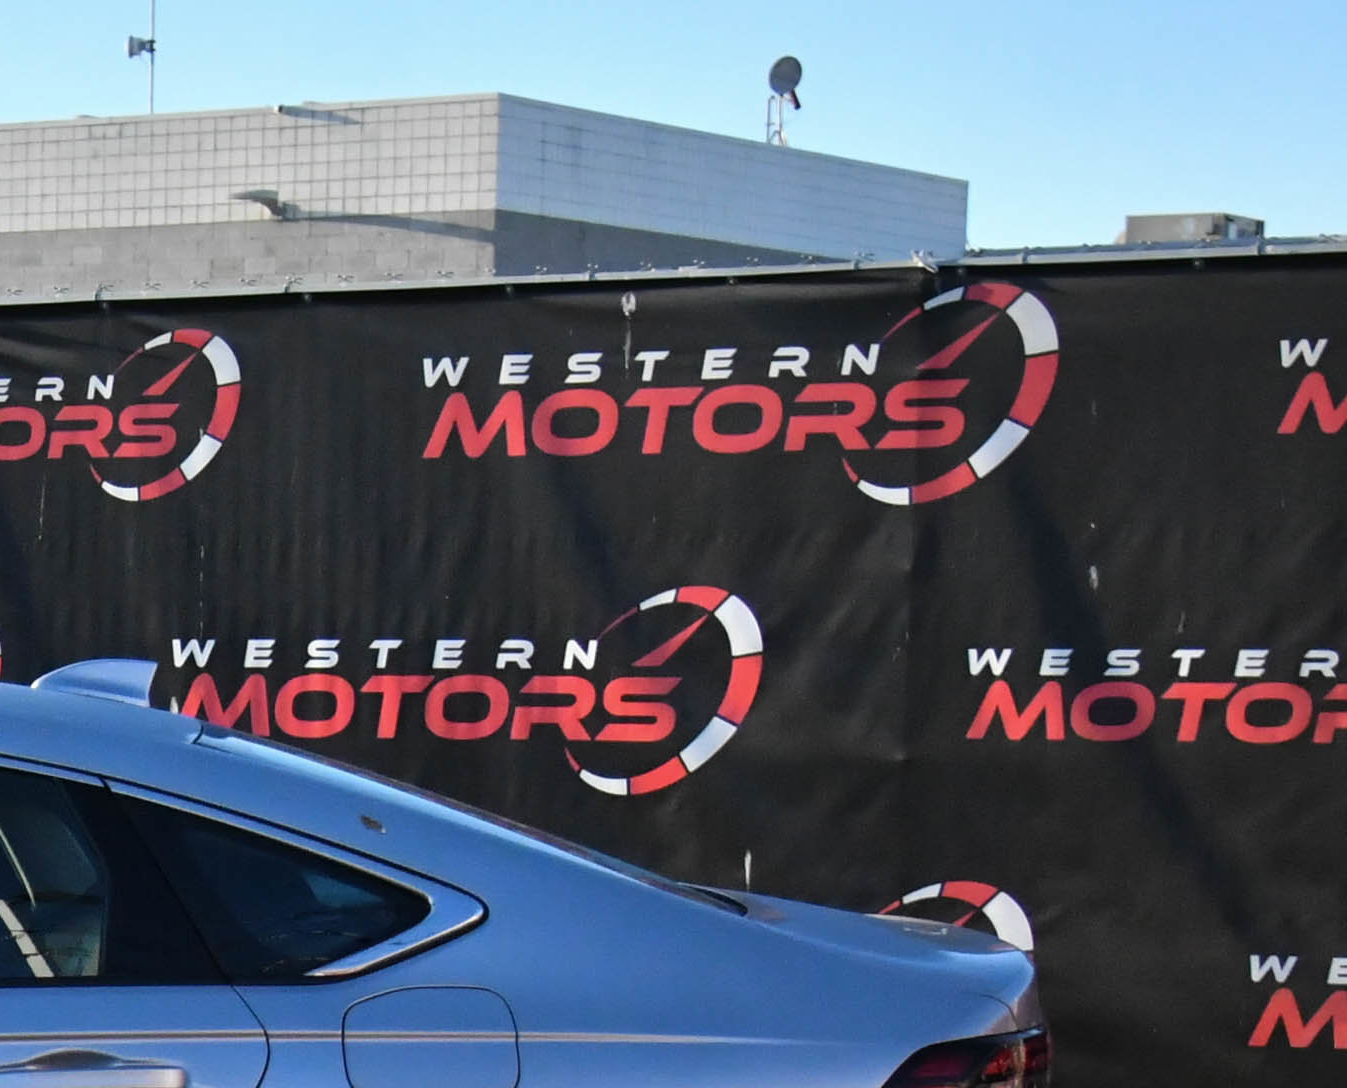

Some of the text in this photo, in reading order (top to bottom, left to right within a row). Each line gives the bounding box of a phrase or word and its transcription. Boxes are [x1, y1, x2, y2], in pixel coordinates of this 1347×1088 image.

[422, 344, 880, 387] WESTERN
[422, 378, 969, 459] MOTORS
[171, 639, 598, 669] WESTERN
[967, 648, 1340, 678] WESTER
[181, 673, 683, 742] MOTORS
[965, 679, 1347, 745] MOTO
